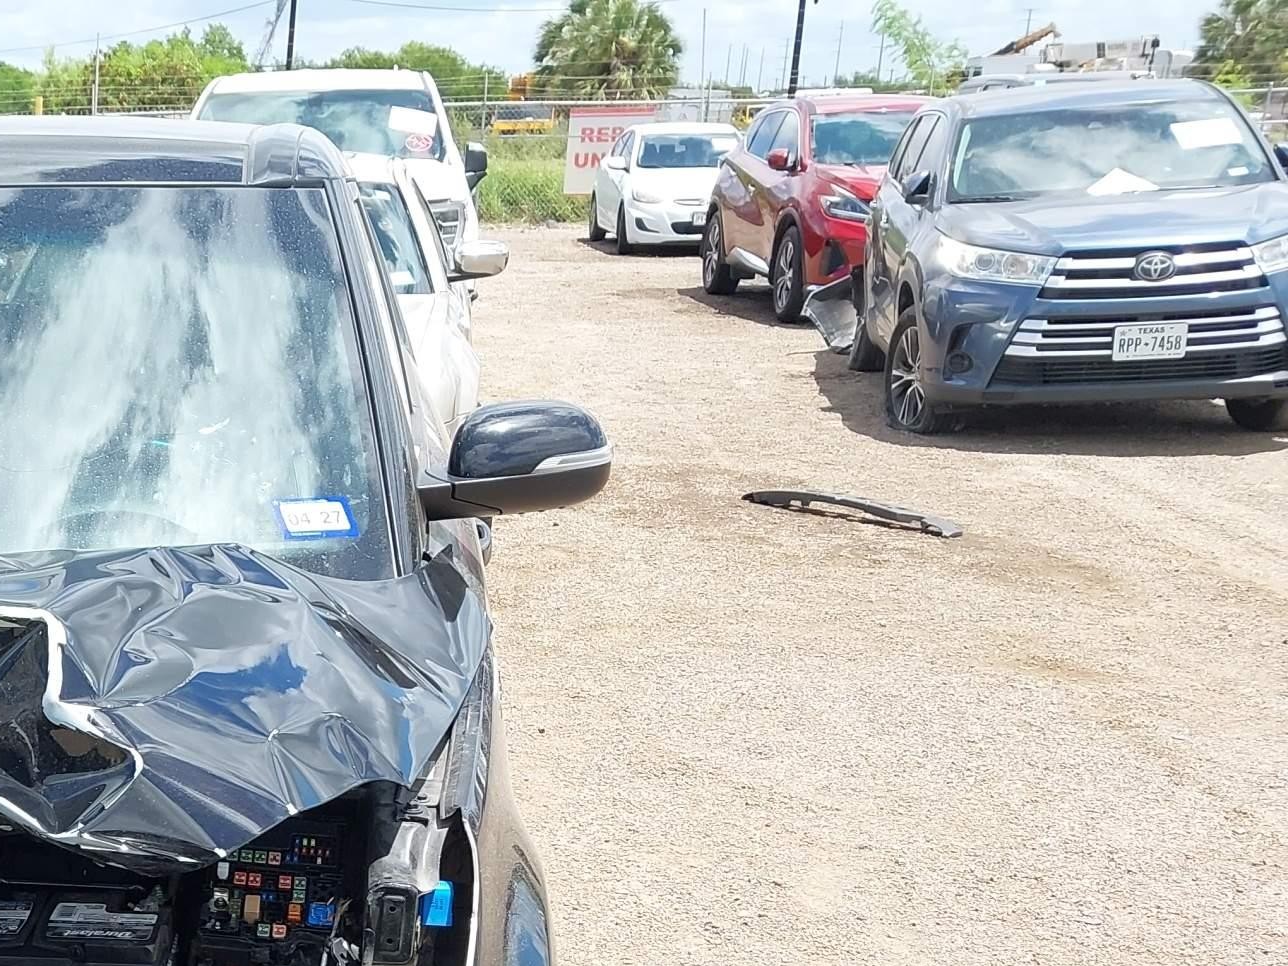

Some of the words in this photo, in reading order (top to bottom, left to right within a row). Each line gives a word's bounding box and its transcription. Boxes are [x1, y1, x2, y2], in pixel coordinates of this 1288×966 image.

[1138, 327, 1165, 335] TEXAS
[288, 511, 310, 526] 04
[320, 511, 340, 524] 27
[63, 929, 133, 938] Duralast
